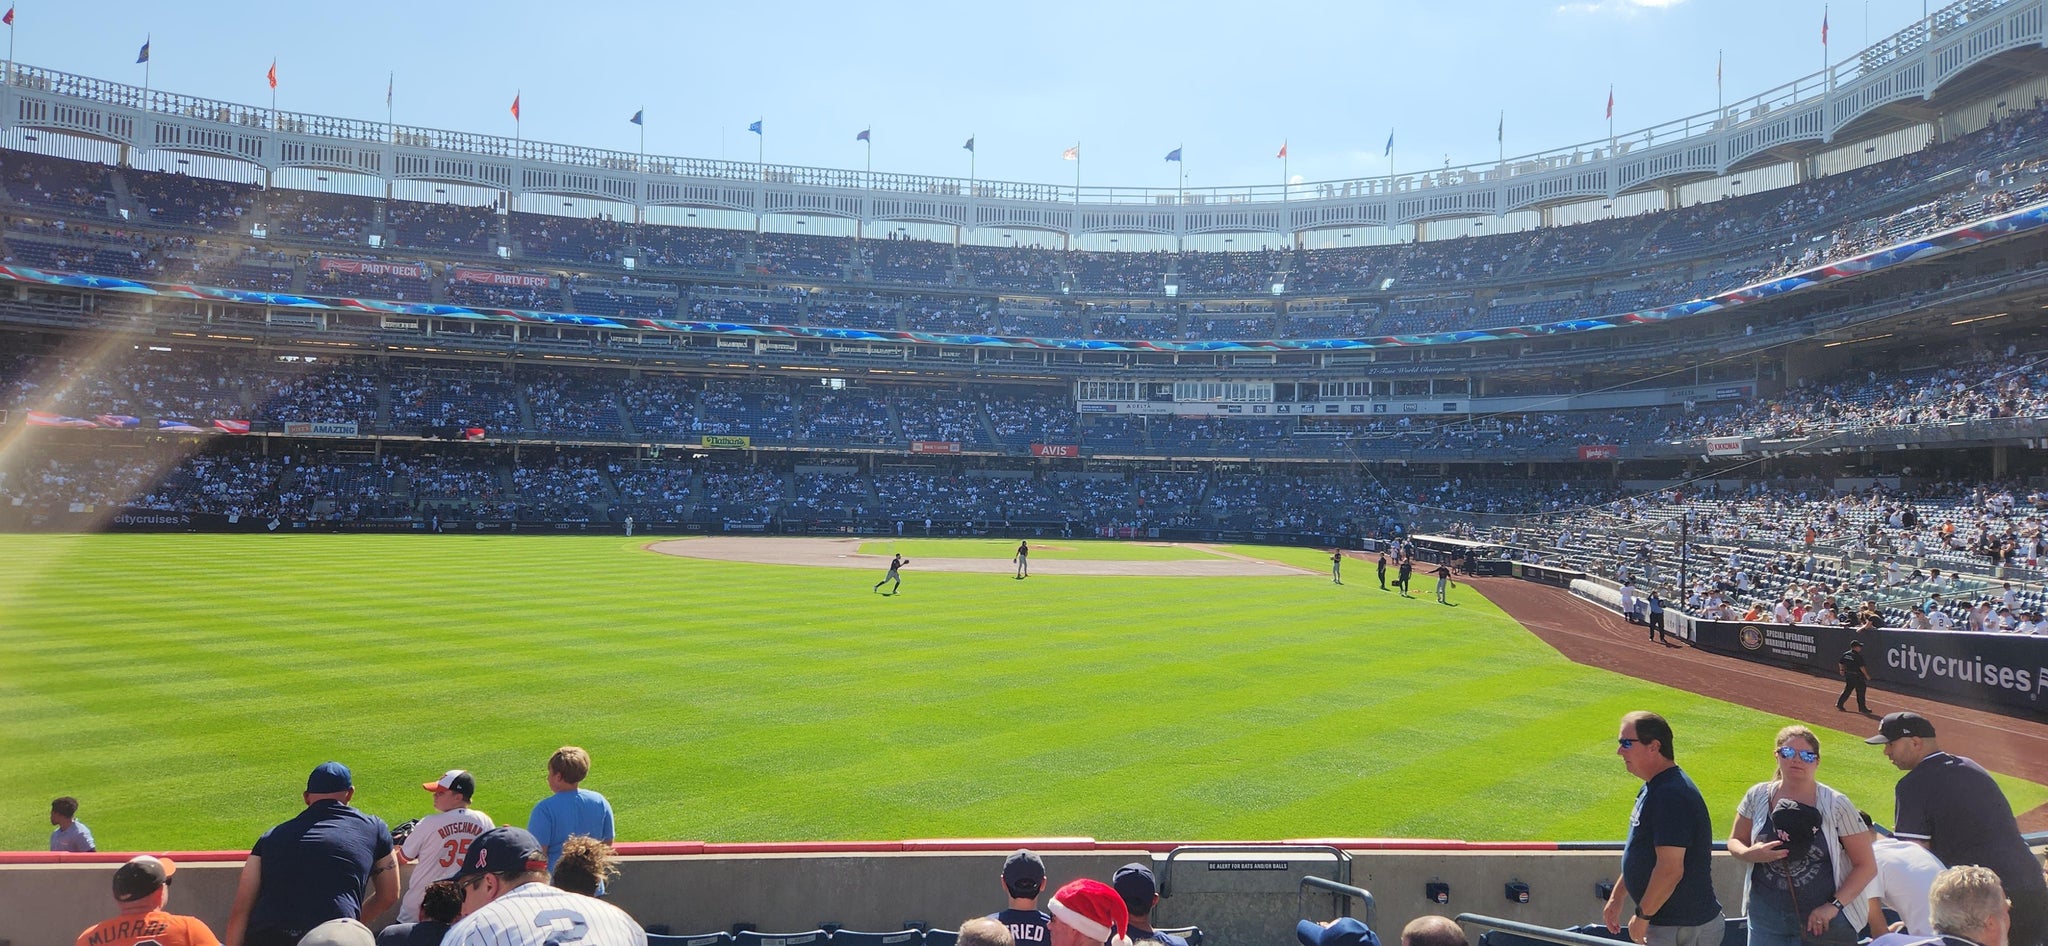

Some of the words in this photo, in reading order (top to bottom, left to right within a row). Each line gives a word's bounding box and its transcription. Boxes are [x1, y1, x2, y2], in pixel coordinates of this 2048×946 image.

[361, 263, 390, 274] PARTY
[392, 265, 417, 277] DECK
[494, 274, 522, 285] PARTY
[523, 276, 546, 287] DECK
[1398, 366, 1420, 374] World
[1420, 366, 1456, 374] Champions
[313, 425, 355, 434] AMAZING
[1041, 446, 1067, 455] AVIS
[1714, 441, 1740, 451] KIKKOMAN
[114, 514, 179, 526] citycruises
[1766, 629, 1785, 640] SPECIAL
[1785, 632, 1815, 644] OPERATIONS
[1765, 637, 1786, 649] WARRIOR
[1786, 641, 1817, 654] FOUNDATION
[1887, 643, 2032, 692] citycruises
[438, 838, 473, 868] 35
[1006, 923, 1044, 942] RIED
